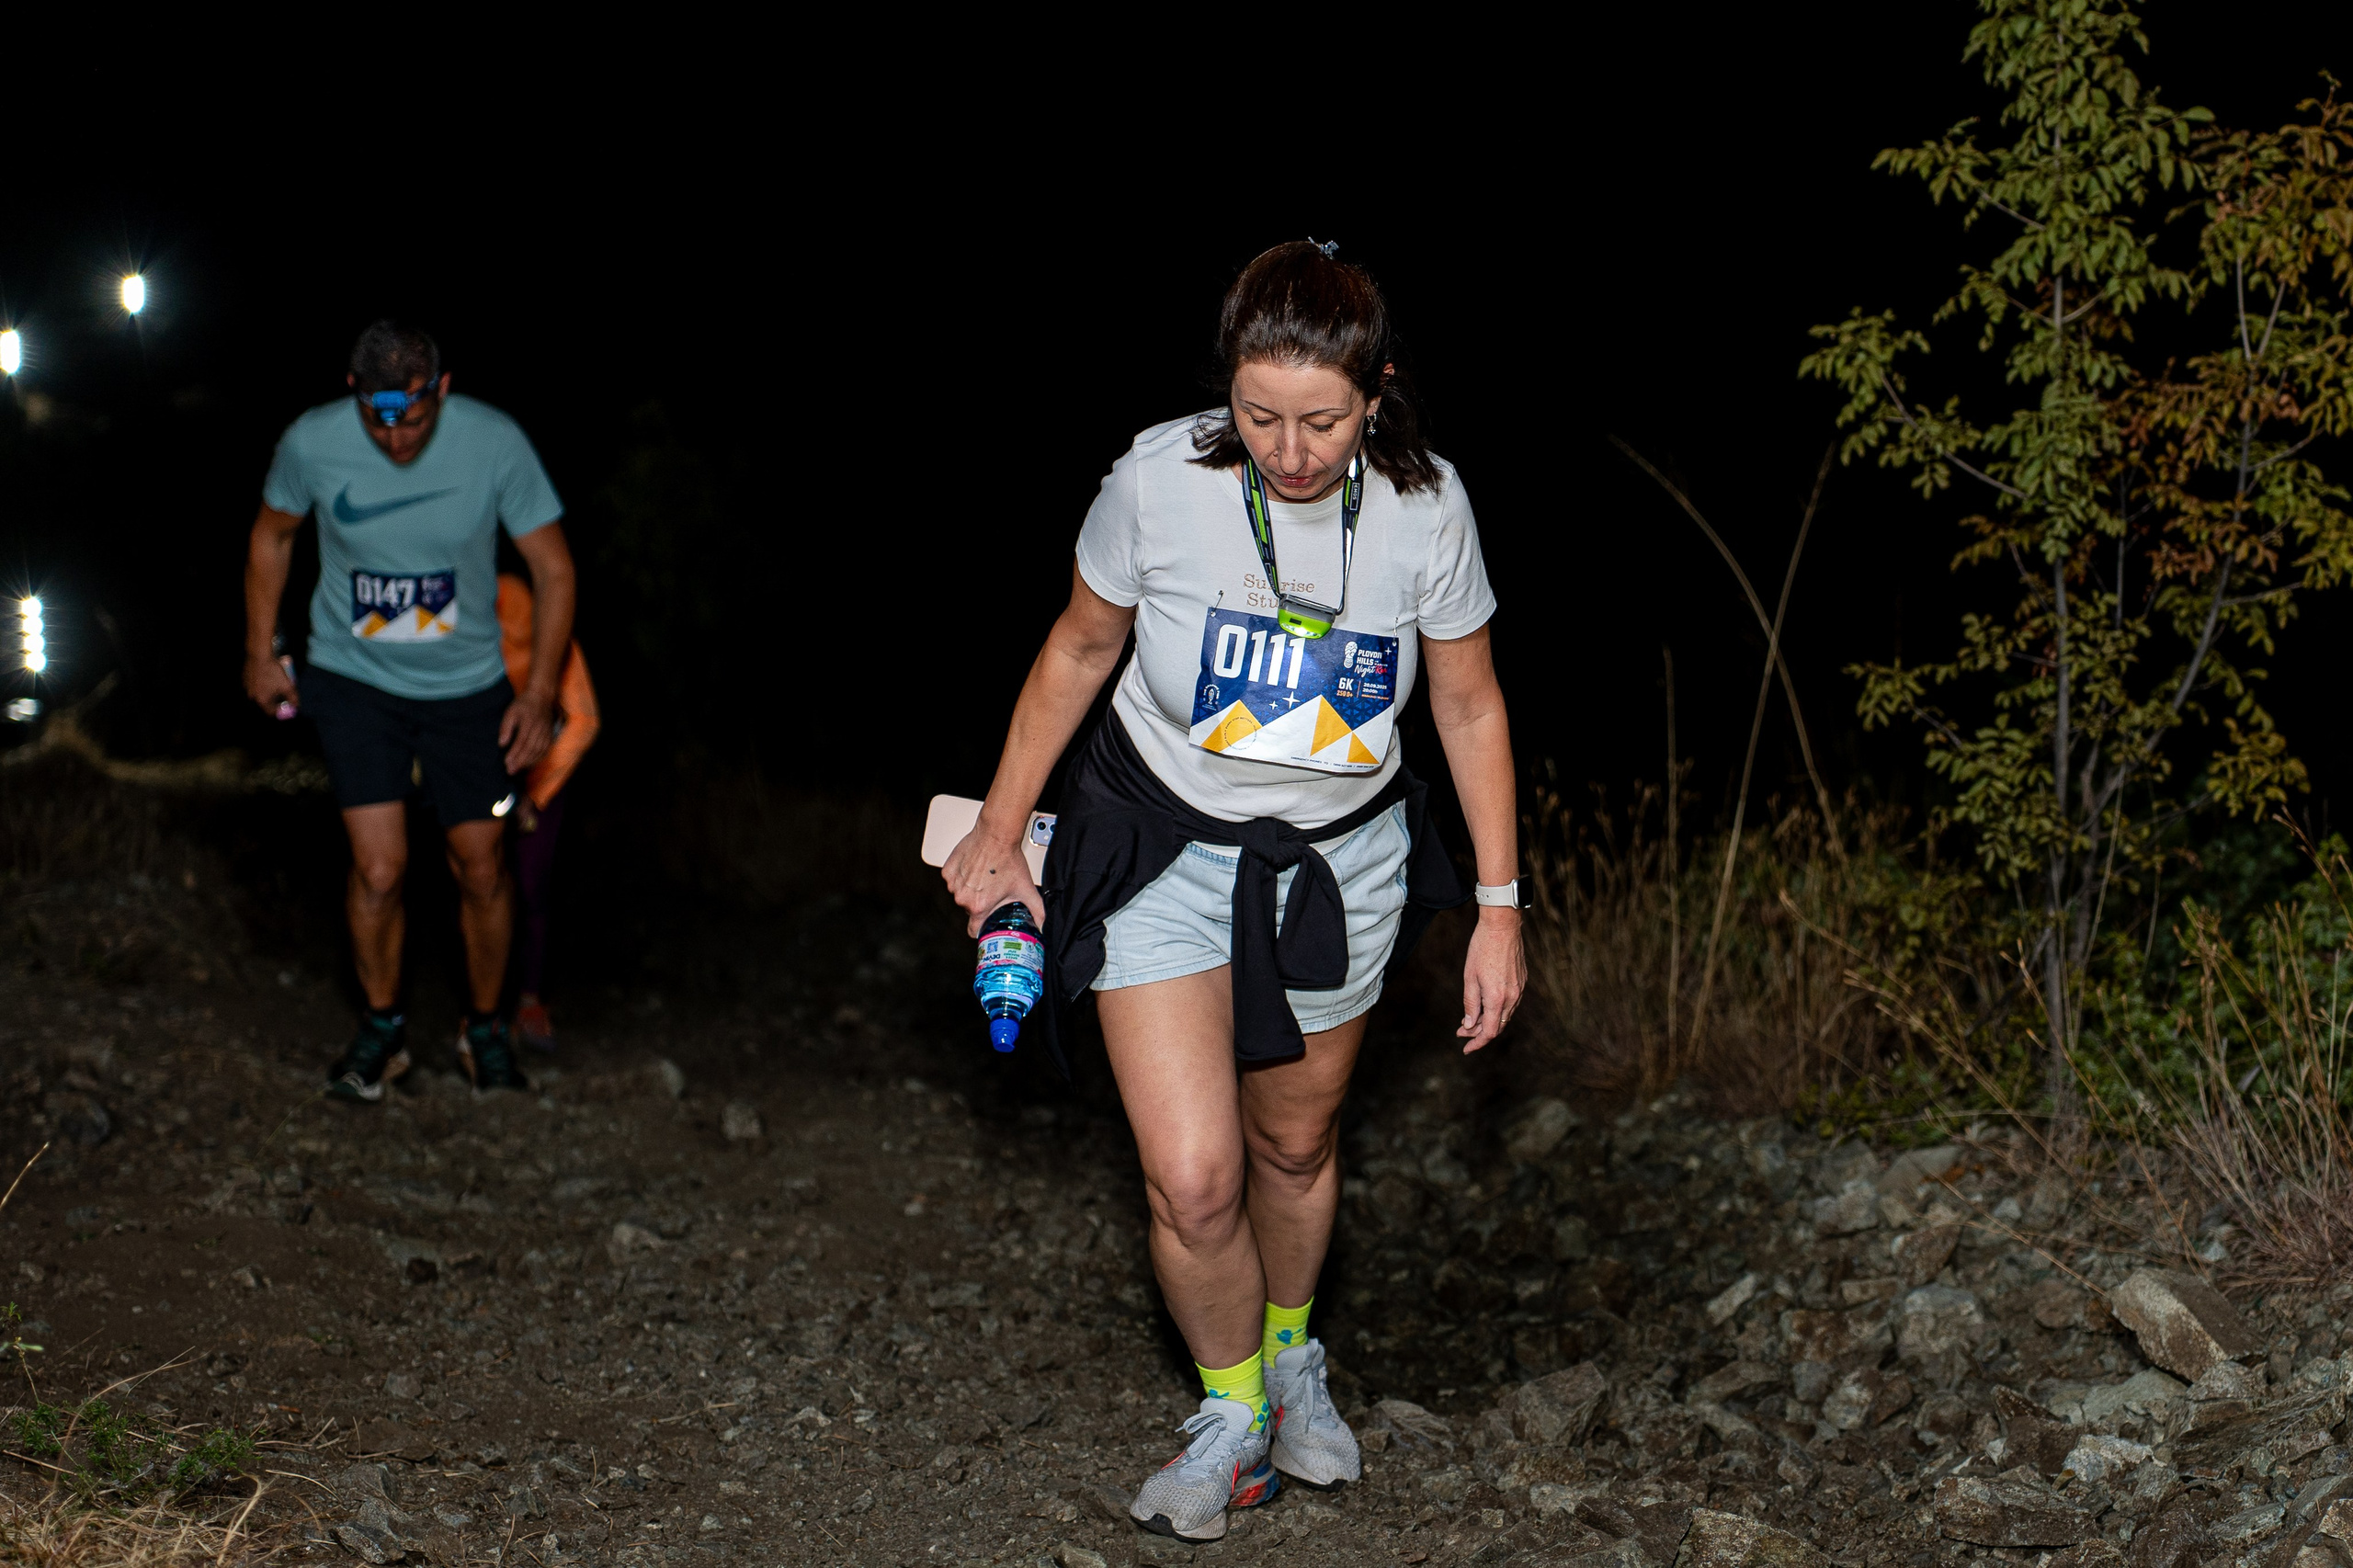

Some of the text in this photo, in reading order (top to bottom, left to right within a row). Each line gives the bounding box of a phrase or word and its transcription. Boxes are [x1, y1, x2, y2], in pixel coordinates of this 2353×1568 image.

[356, 574, 415, 608] 0147
[1243, 574, 1315, 593] Surise
[1246, 592, 1279, 608] Stu
[1213, 624, 1306, 689] 0111
[1357, 657, 1374, 665] HILLS
[1354, 665, 1375, 677] Night
[1338, 677, 1354, 690] 6K
